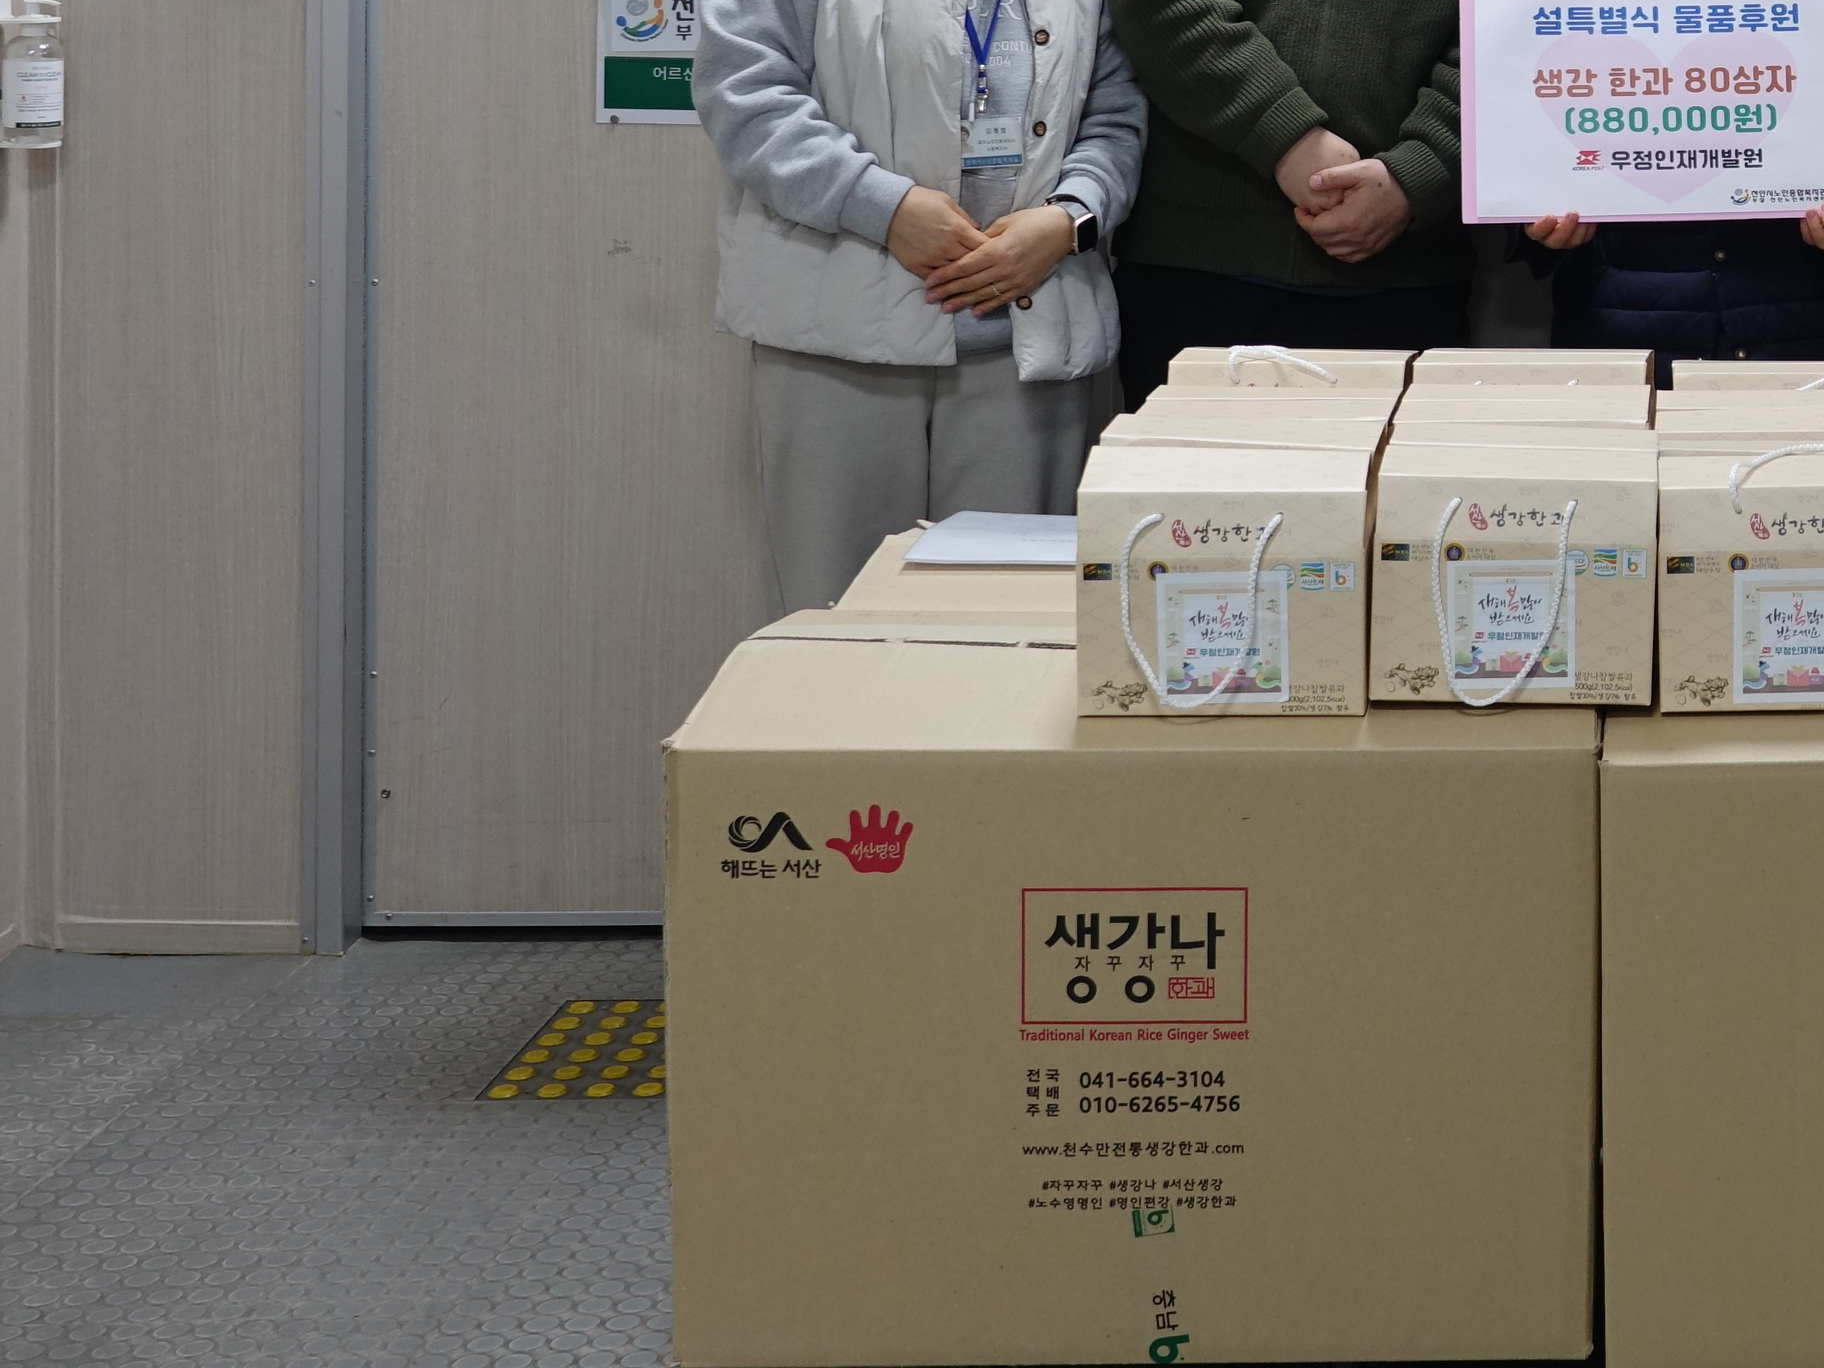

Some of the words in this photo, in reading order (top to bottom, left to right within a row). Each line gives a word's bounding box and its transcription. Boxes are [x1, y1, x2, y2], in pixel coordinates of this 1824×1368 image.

[1532, 5, 1660, 36] 설특별식
[1673, 3, 1800, 33] 물품후원
[1532, 68, 1597, 99] 생강
[1609, 66, 1673, 97] 한과
[1684, 64, 1797, 95] 80상자
[1564, 103, 1778, 136] (880,000원)
[1610, 148, 1764, 171] 우정인재개발원
[1766, 608, 1793, 624] 새해
[1793, 598, 1807, 627] 복
[1776, 626, 1822, 641] 받으세요
[720, 859, 778, 880] 해뜨는
[782, 858, 823, 880] 서산
[1044, 911, 1226, 1004] 생강나
[1019, 1028, 1085, 1043] Traditional
[1088, 1028, 1132, 1042] Korean
[1136, 1028, 1162, 1042] Rice
[1167, 1028, 1209, 1044] Ginger
[1212, 1028, 1250, 1042] Sweet
[1079, 1069, 1227, 1090] 041-664-3104
[1079, 1094, 1241, 1114] 010-6265-4756
[1022, 1140, 1245, 1158] www.천수만전통생강한과.com
[1042, 1179, 1104, 1192] #자꾸자꾸
[1108, 1178, 1157, 1192] #생강나
[1162, 1178, 1224, 1191] #서산생강
[1028, 1196, 1103, 1210] #노수영명인
[1108, 1196, 1170, 1209] #명인편강
[1176, 1195, 1238, 1209] #생강한과
